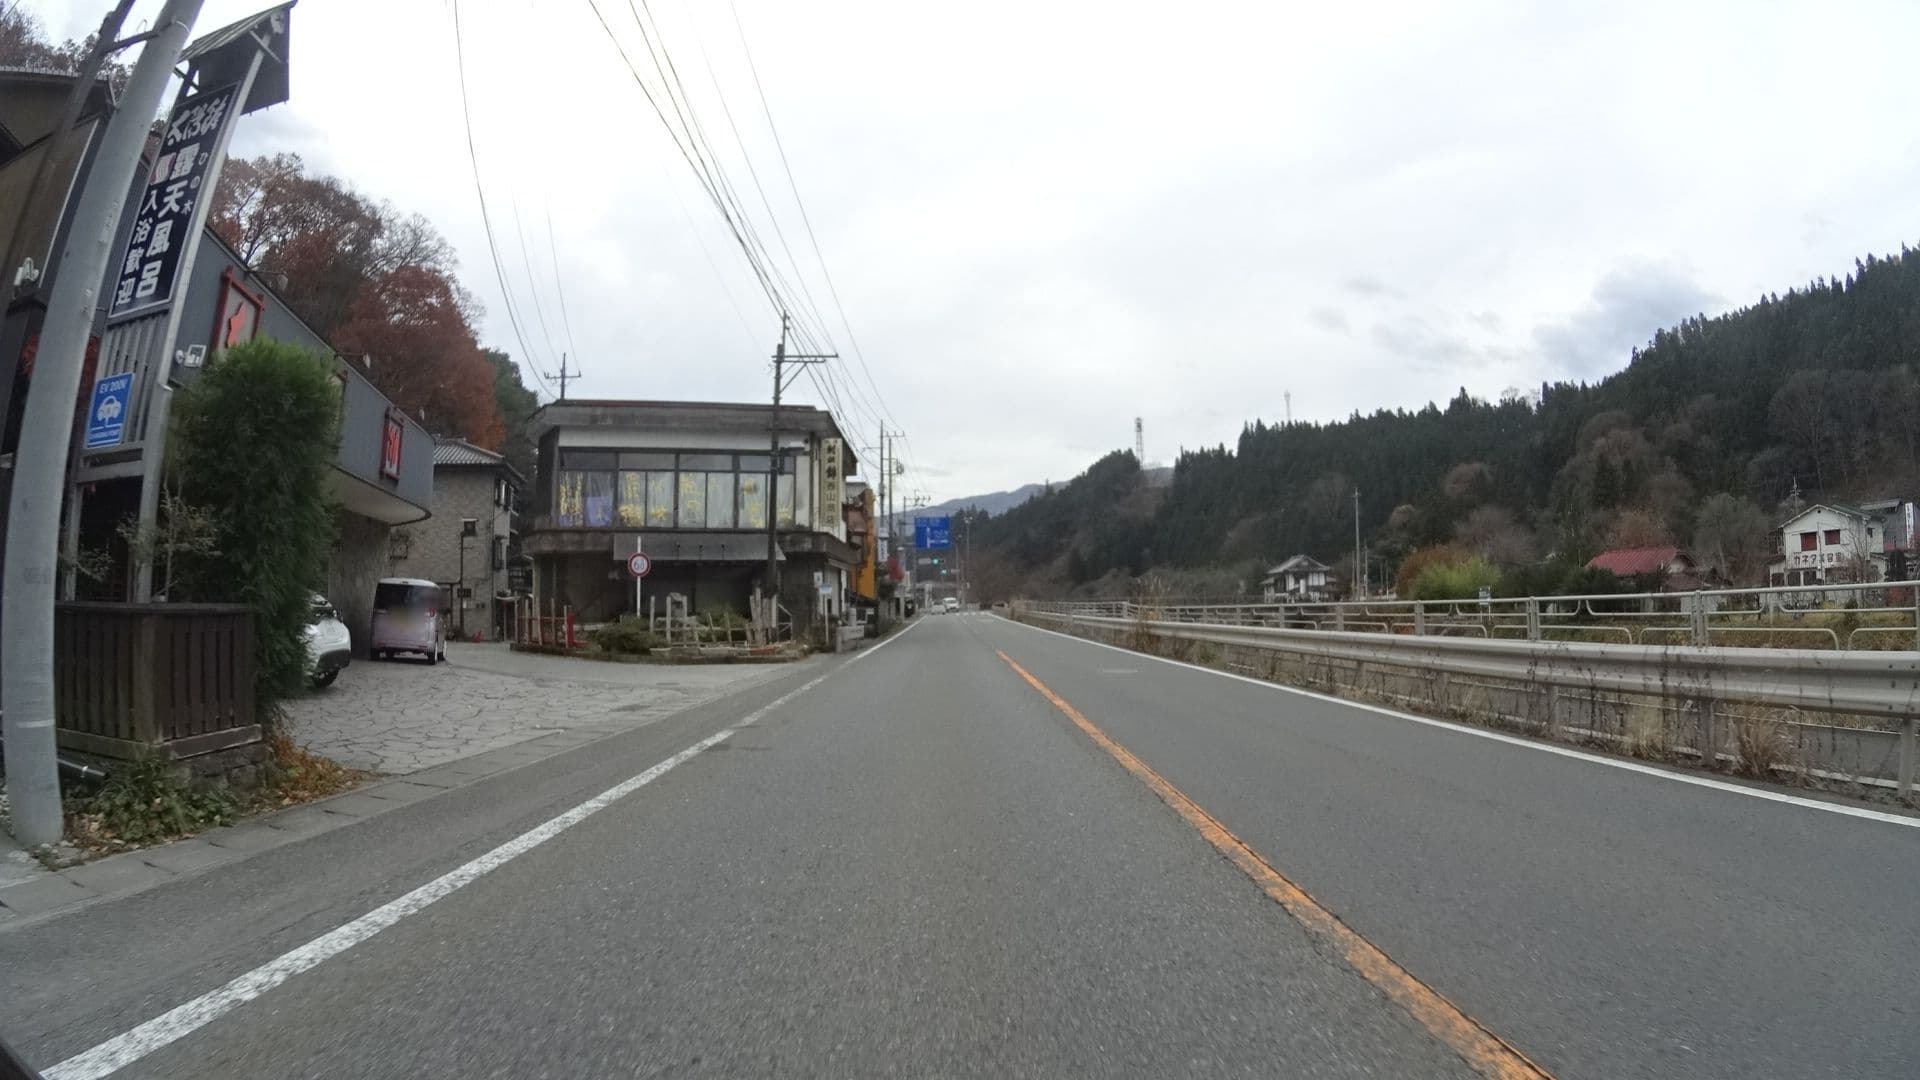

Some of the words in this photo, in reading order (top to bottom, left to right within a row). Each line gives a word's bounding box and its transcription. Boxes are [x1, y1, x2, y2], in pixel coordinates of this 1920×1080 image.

[116, 189, 158, 306] 入浴歓迎
[135, 142, 200, 299] 露天風呂
